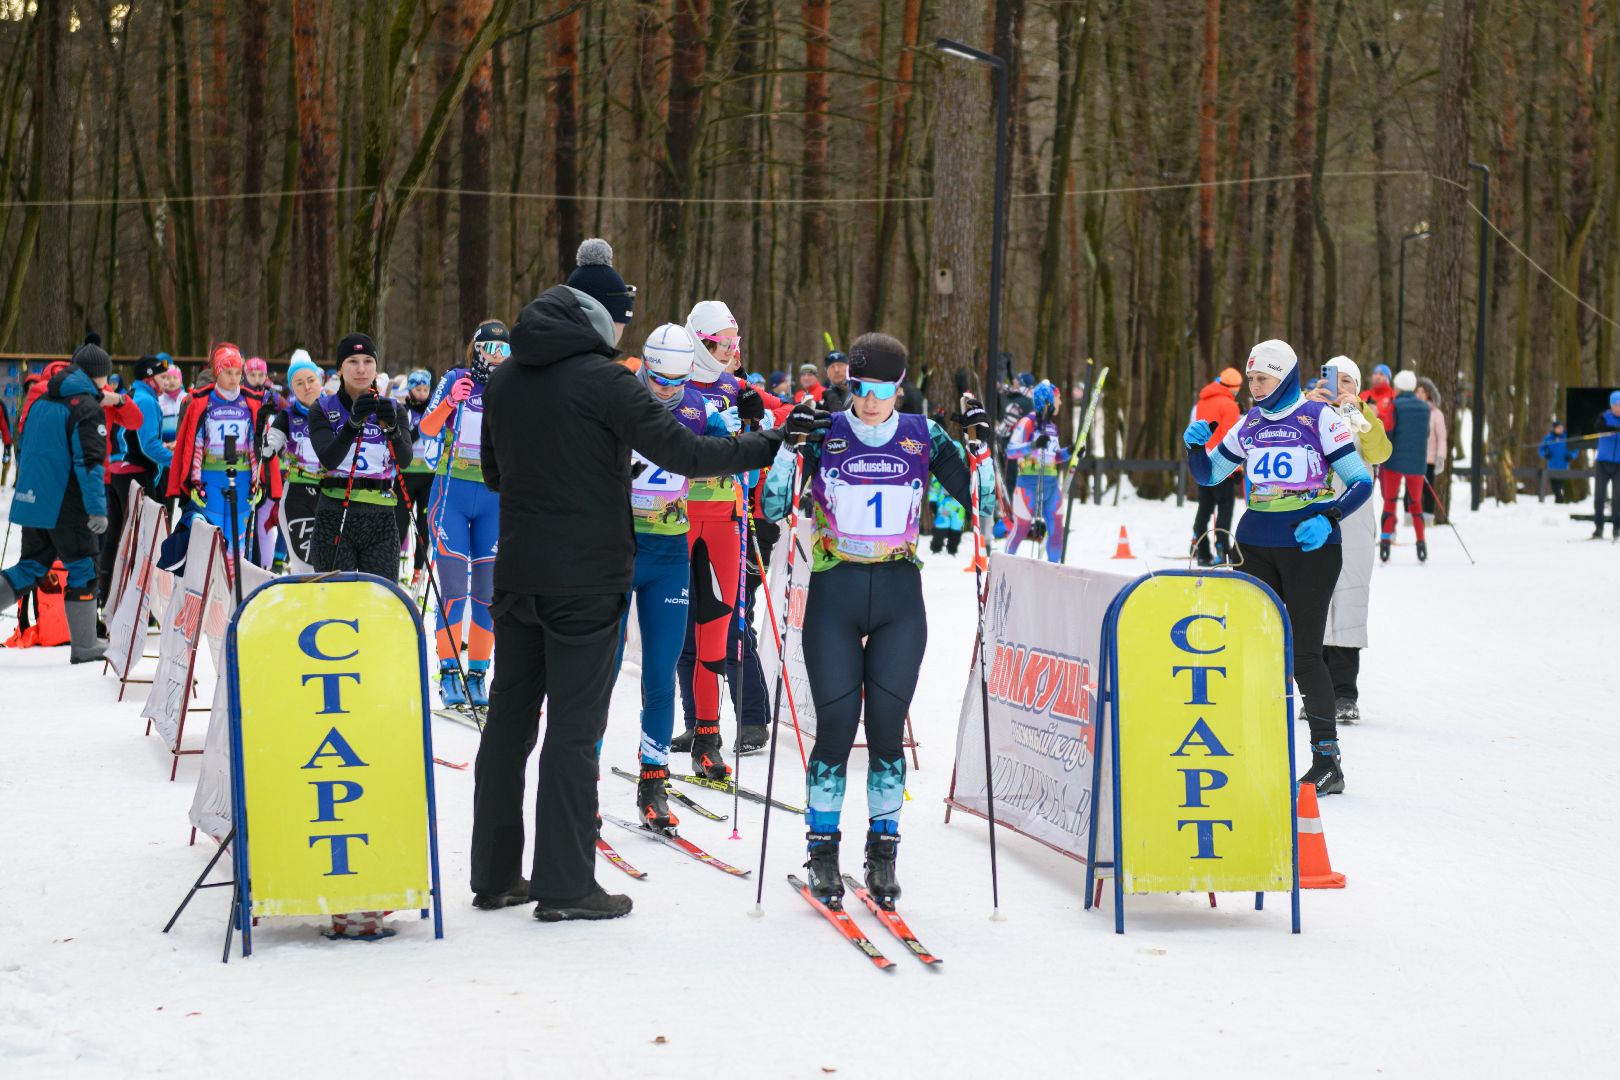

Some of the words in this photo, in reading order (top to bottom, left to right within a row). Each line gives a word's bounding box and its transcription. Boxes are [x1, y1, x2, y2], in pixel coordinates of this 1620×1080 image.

[218, 423, 240, 441] 13
[354, 447, 369, 471] 5
[848, 459, 904, 474] volkuscha.ru
[1253, 451, 1293, 479] 46
[866, 491, 883, 528] 1
[987, 641, 1091, 726] ВОЛКУША
[298, 617, 370, 877] СТАРТ
[1049, 732, 1089, 773] клуб
[1170, 614, 1235, 860] СТАРТ
[684, 775, 728, 792] FISCHER
